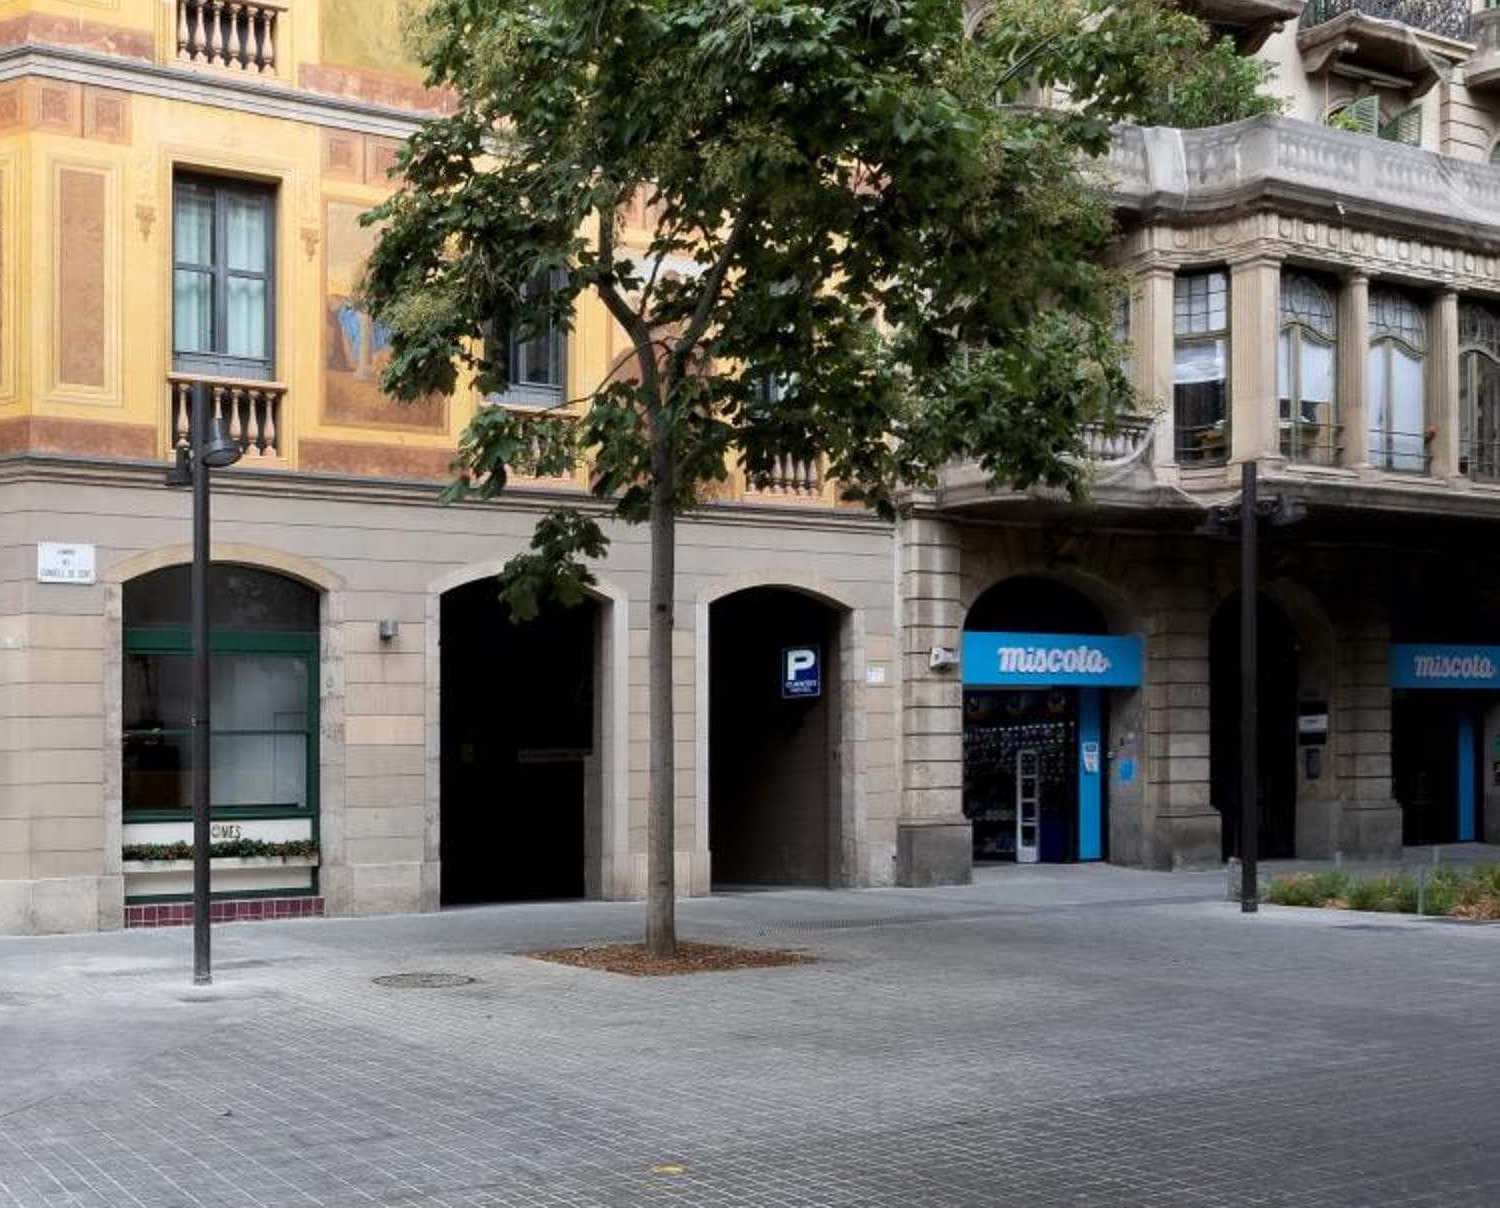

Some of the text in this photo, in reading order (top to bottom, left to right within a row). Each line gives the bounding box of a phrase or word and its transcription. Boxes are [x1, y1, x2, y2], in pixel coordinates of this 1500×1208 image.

[787, 649, 815, 680] P
[997, 646, 1111, 673] miscota
[1414, 654, 1496, 678] miscota
